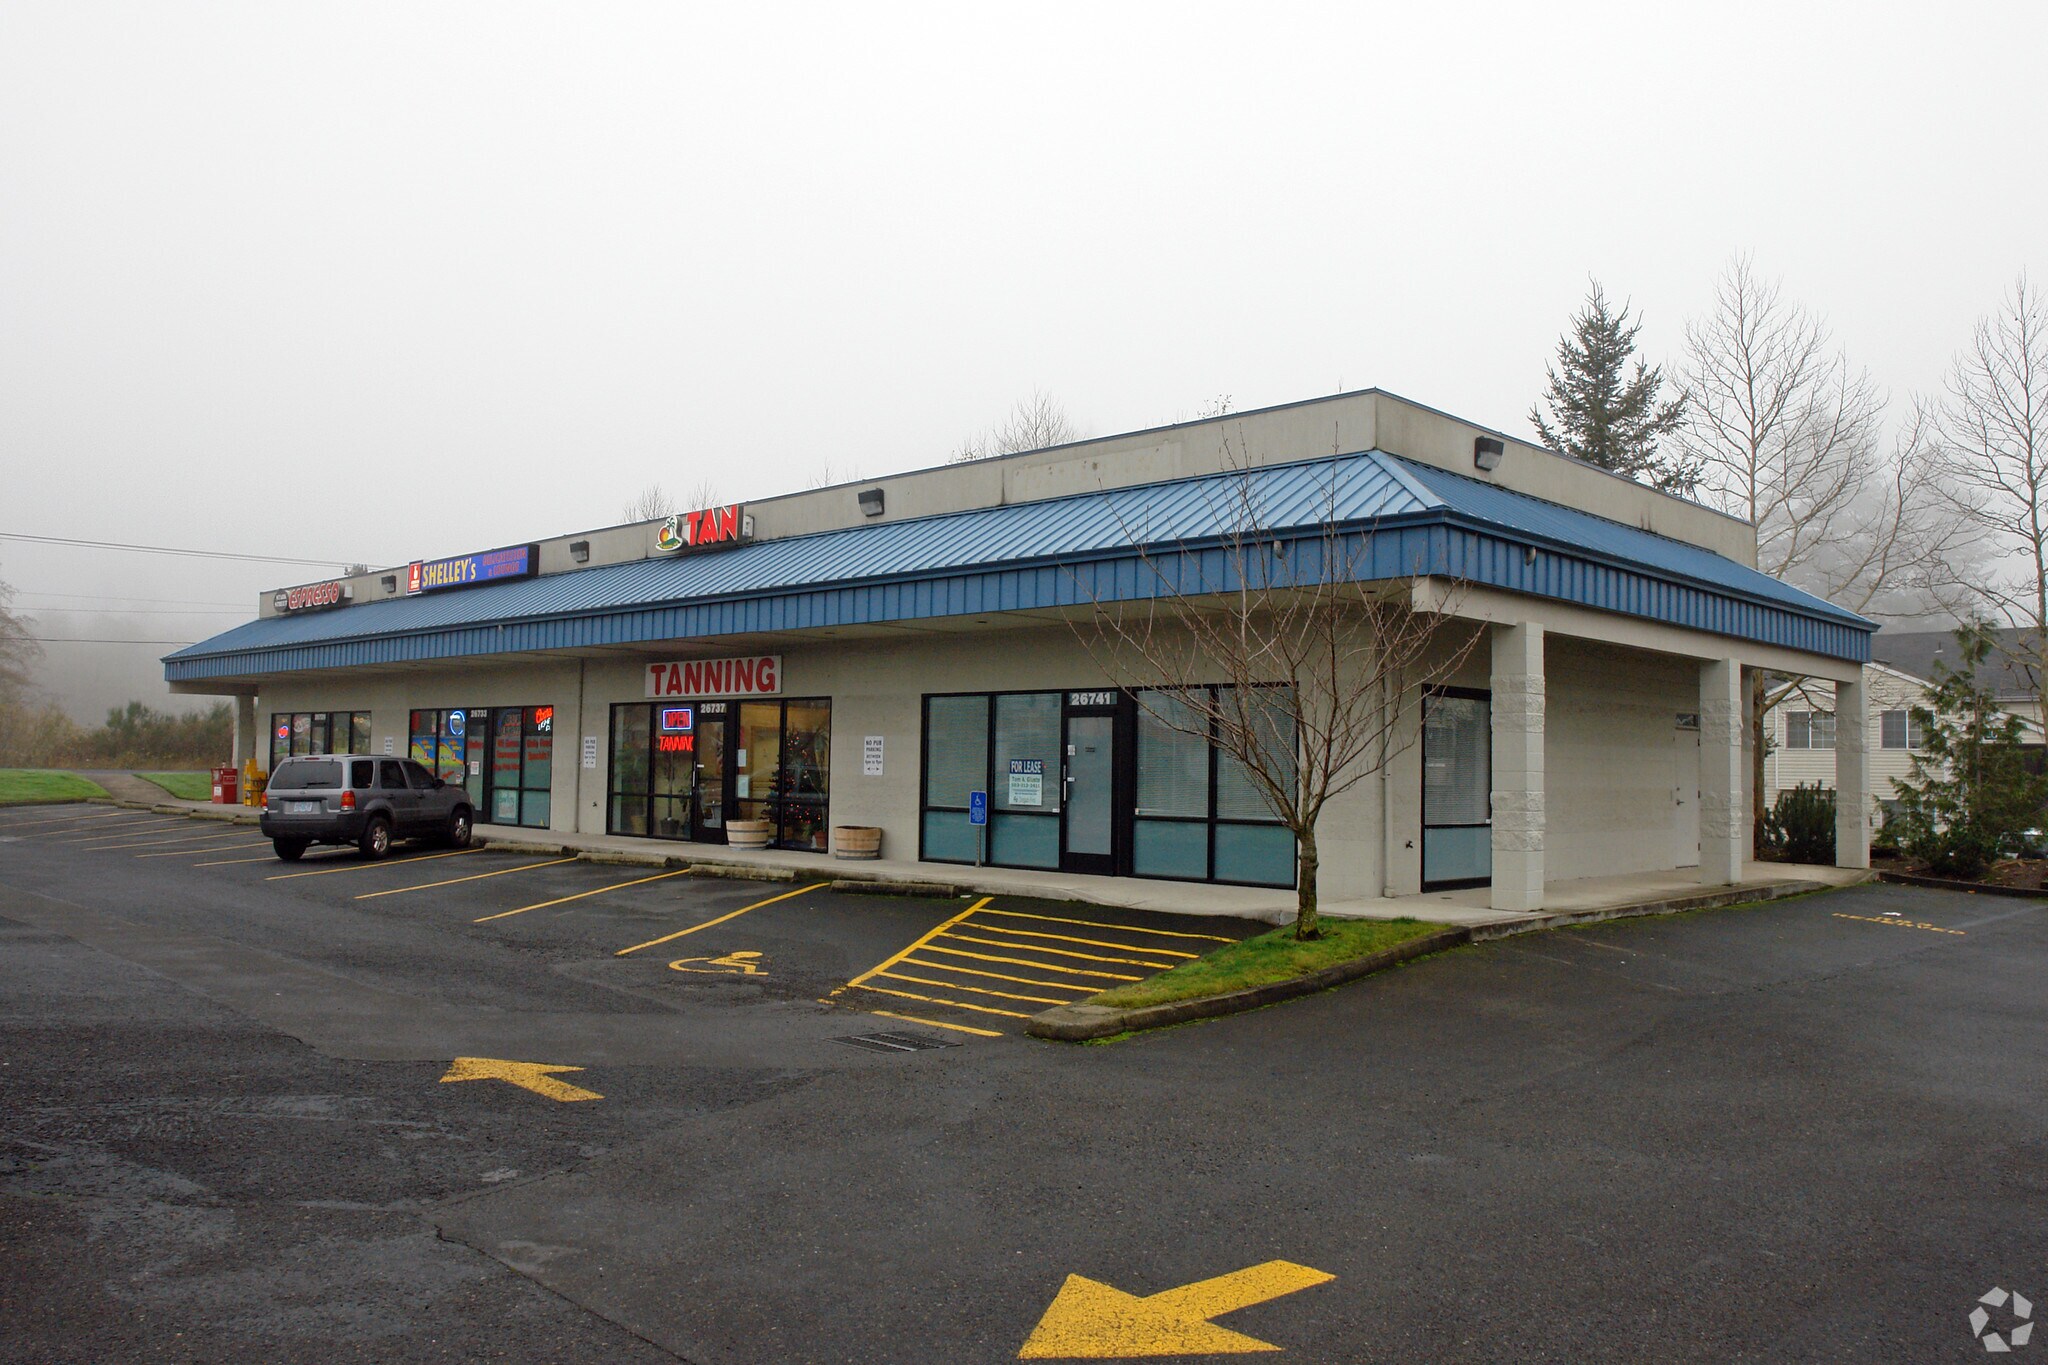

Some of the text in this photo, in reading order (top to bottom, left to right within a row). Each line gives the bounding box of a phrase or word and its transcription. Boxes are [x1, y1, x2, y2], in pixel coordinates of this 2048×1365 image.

[687, 504, 738, 546] TAN
[289, 581, 339, 609] ESPRESSO
[650, 657, 776, 695] TANNING
[1071, 692, 1111, 705] 26741
[700, 703, 725, 714] 26737
[665, 711, 689, 728] OPEN
[1011, 760, 1041, 773] FOR LEASE
